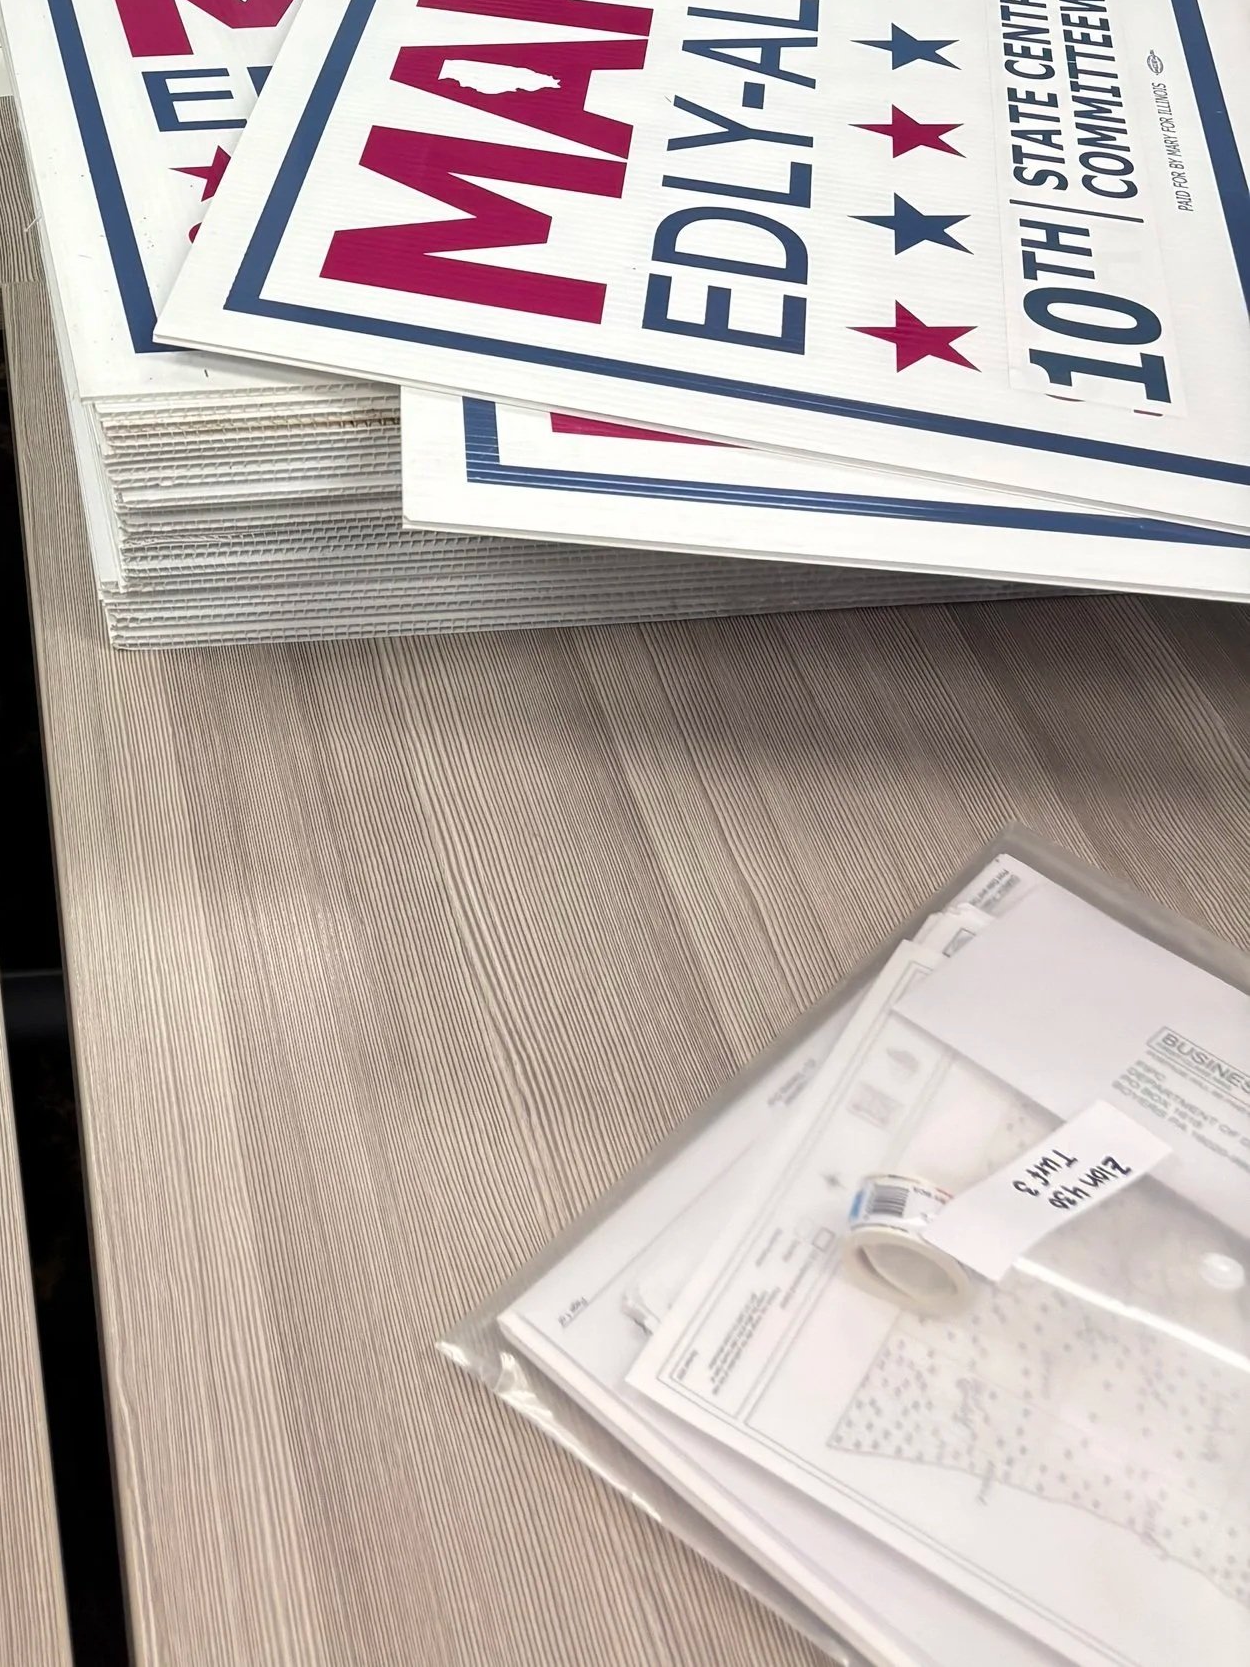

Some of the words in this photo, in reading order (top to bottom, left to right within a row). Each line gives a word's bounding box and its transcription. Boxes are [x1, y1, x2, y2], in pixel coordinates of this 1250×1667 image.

[1151, 82, 1173, 116] ILLINOIS
[1159, 116, 1176, 133] FOR
[1005, 86, 1069, 192] STATE
[1164, 134, 1182, 157] MARY
[1168, 157, 1184, 170] BY
[1171, 171, 1189, 190] FOR
[1175, 190, 1194, 212] PAID
[1022, 219, 1172, 404] 10TH
[1012, 1180, 1040, 1197] 3
